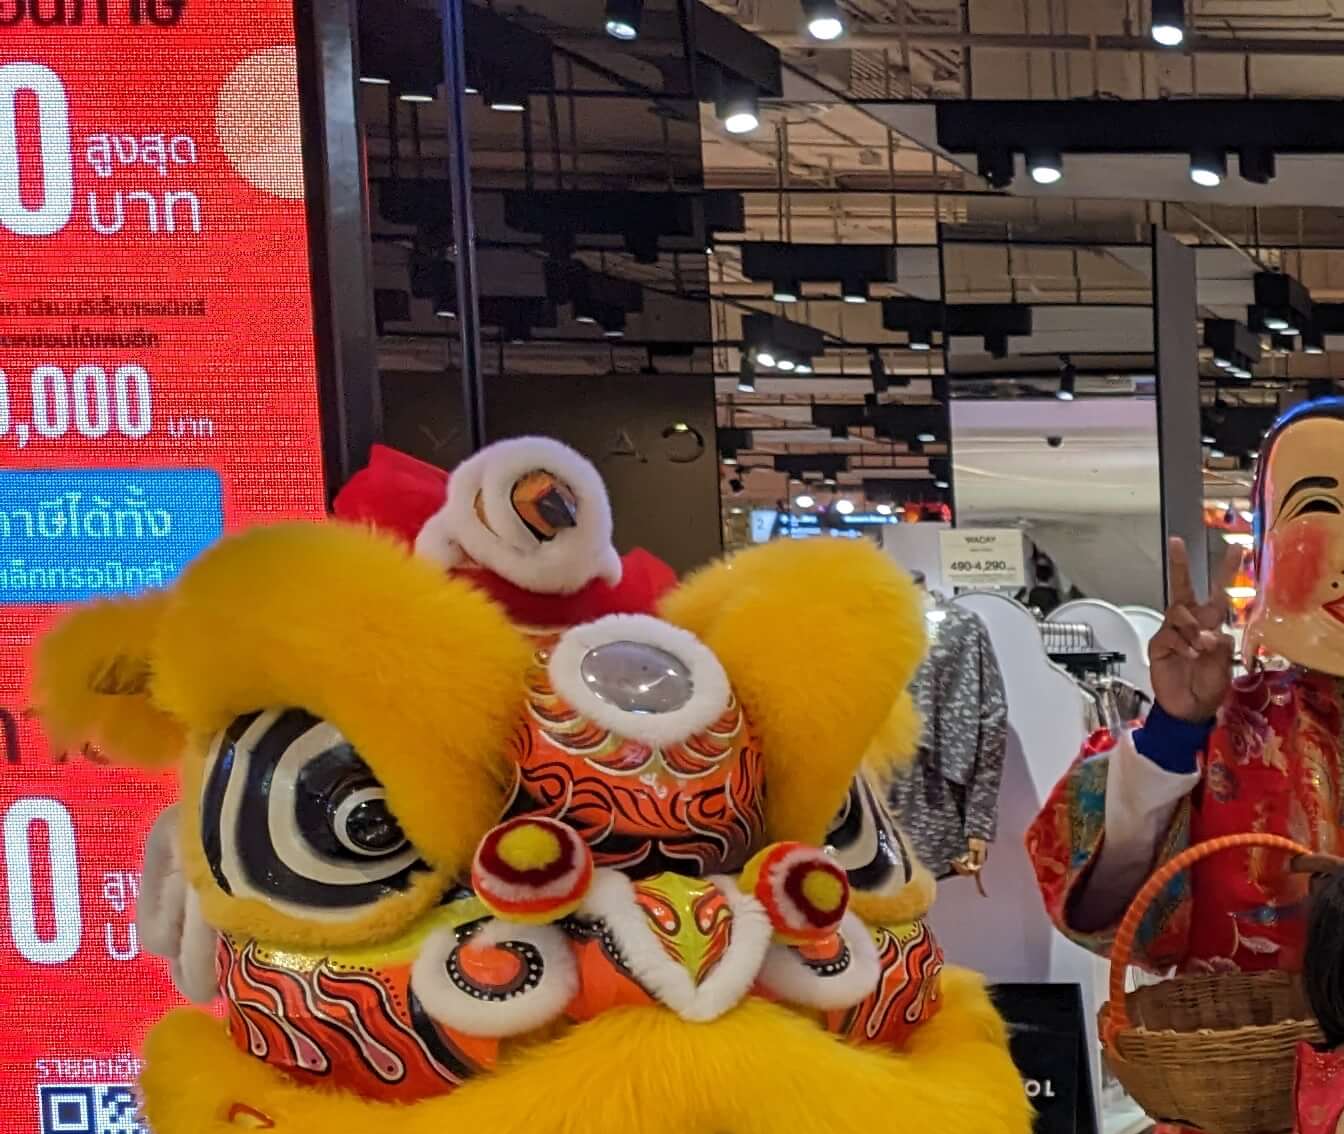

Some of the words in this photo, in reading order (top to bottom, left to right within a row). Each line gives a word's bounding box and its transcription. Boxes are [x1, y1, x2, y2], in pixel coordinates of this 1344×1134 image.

[86, 132, 198, 178] สูงสุด
[88, 191, 202, 235] บาท
[0, 363, 152, 448] ,000
[3, 795, 82, 965] 0
[1024, 1079, 1056, 1097] OL
